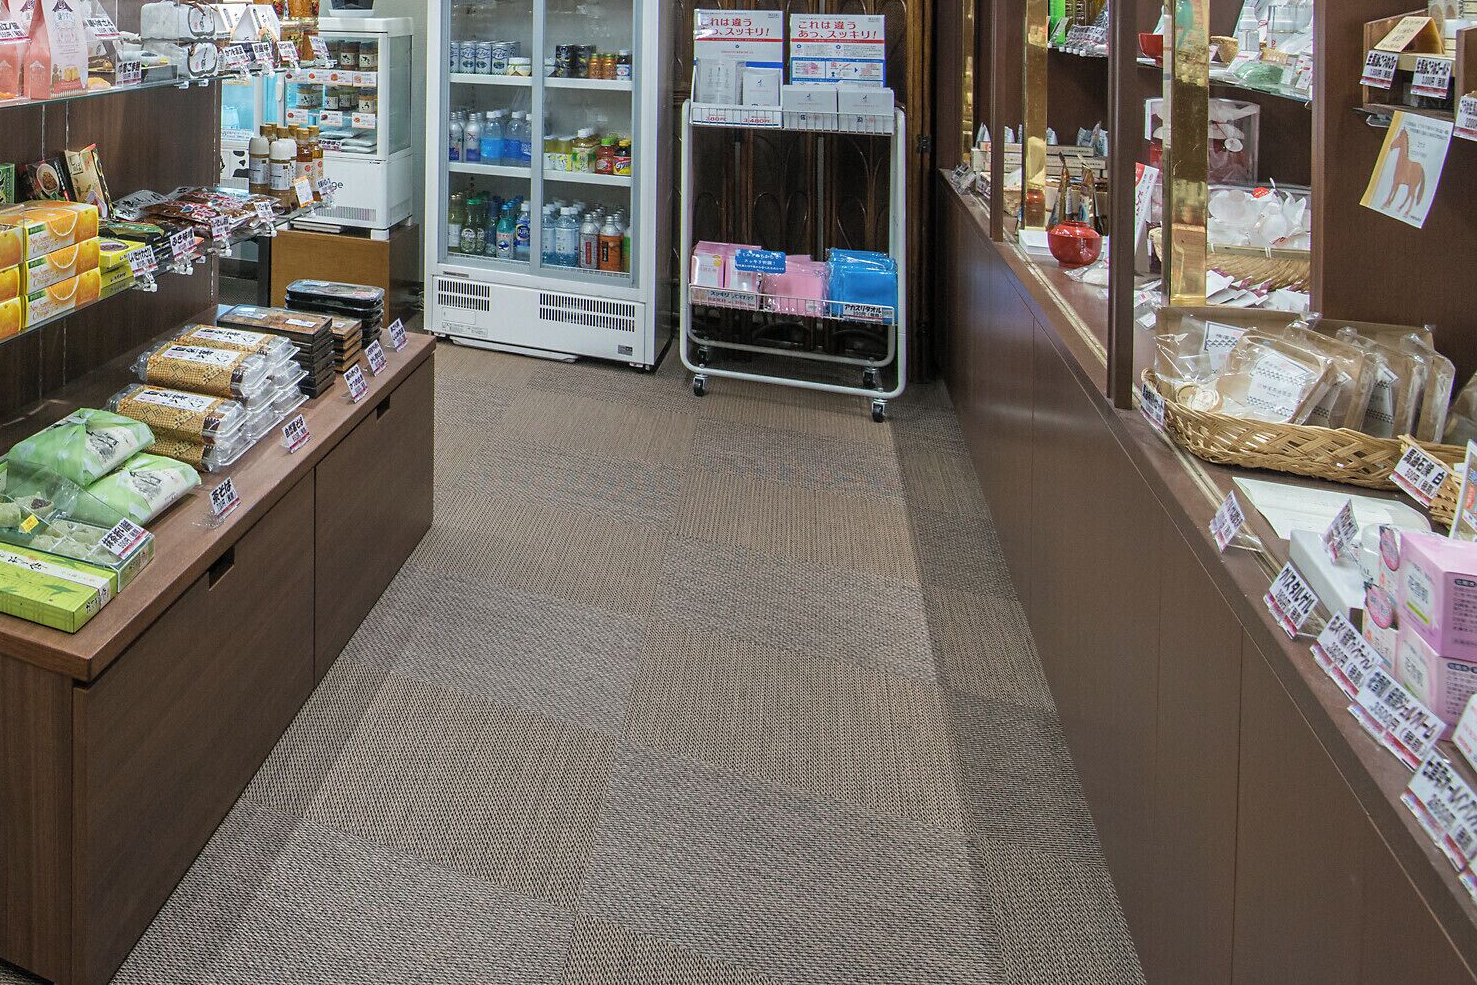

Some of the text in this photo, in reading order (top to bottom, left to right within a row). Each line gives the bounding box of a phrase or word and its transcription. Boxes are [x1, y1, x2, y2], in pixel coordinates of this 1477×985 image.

[798, 21, 857, 30] これは違う
[843, 304, 882, 314] アカスリタオル
[1431, 471, 1445, 486] 白
[211, 480, 232, 502] 茶そば
[1278, 565, 1316, 615] クリスタルゲル
